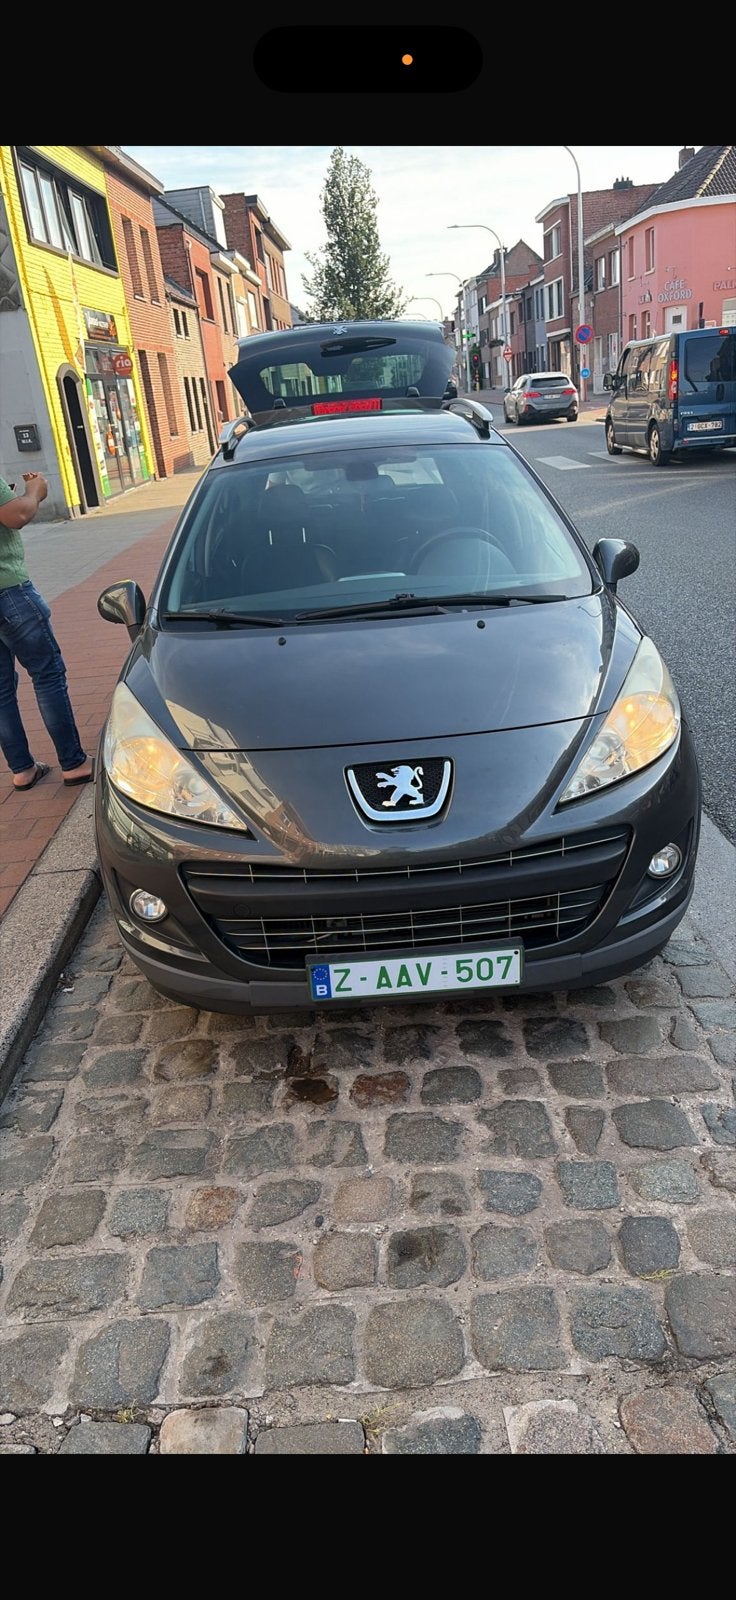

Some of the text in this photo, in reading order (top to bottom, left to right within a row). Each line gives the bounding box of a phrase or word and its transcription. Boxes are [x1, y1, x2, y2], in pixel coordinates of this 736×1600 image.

[665, 280, 685, 291] CAFE
[658, 289, 692, 303] OXFORD
[115, 355, 132, 367] ria
[333, 955, 513, 992] Z-AAV-507
[316, 984, 328, 996] B
